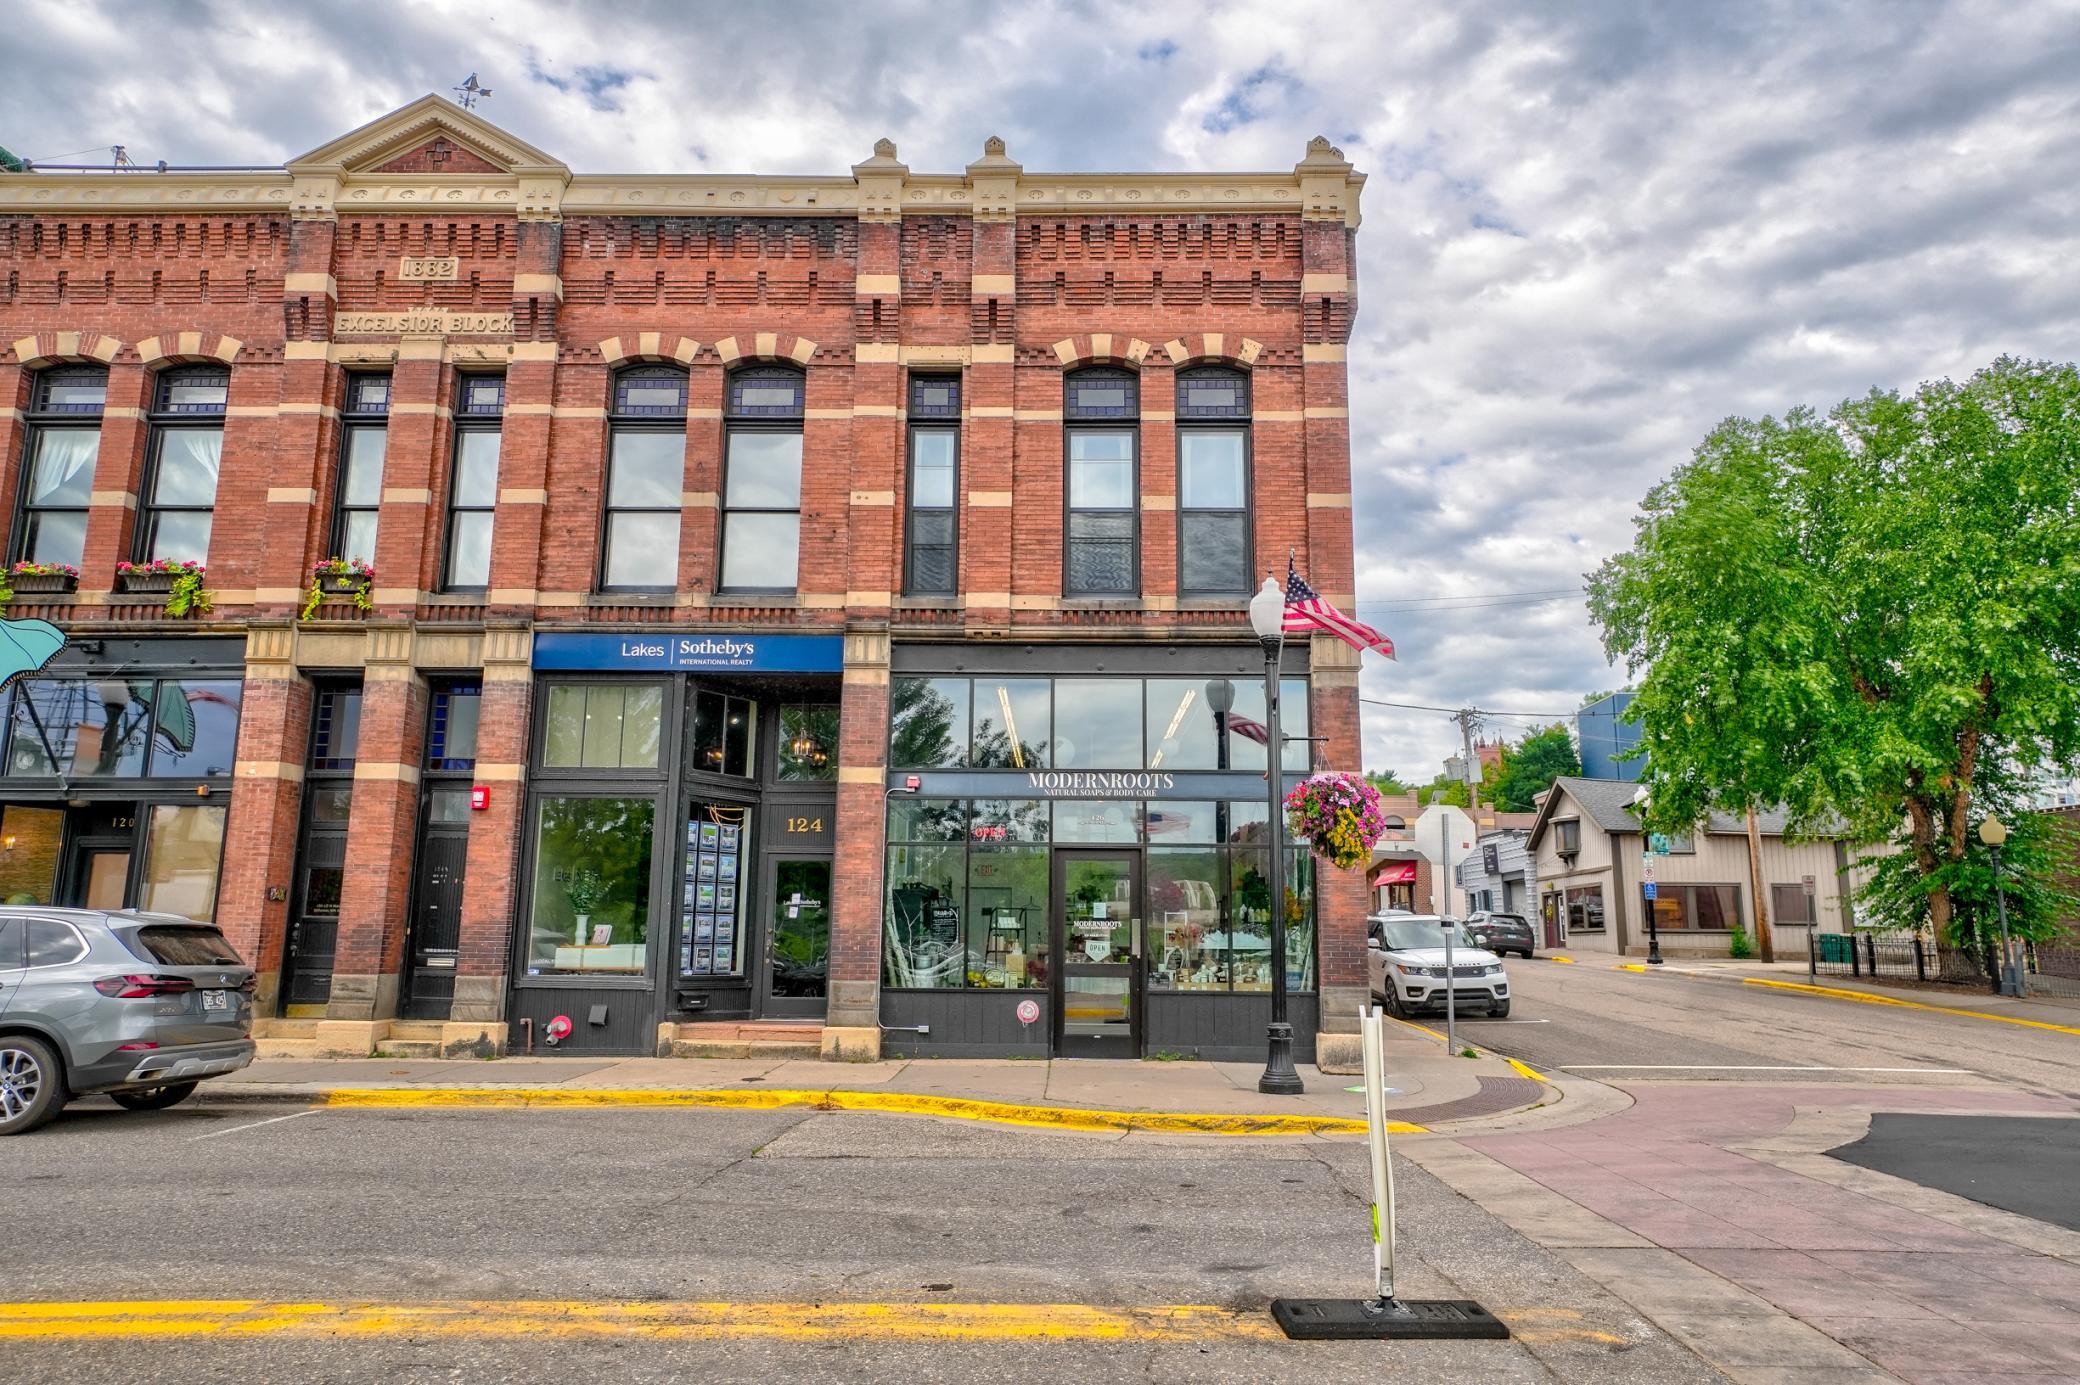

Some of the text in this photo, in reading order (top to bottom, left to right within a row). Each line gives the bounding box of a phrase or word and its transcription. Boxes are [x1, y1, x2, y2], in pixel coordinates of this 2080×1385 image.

[337, 316, 513, 333] EXCELSIOR BLOCK
[622, 643, 665, 656] Lakes
[680, 639, 754, 657] Sotheby's
[1028, 772, 1174, 789] MODERNROOTS
[1045, 788, 1079, 796] NATURAL
[1080, 788, 1105, 796] SOAPS
[1113, 789, 1135, 797] BODY
[1136, 789, 1157, 797] CARE
[112, 817, 135, 828] 120
[787, 818, 824, 832] 124
[1073, 920, 1122, 928] MODERNROOTS
